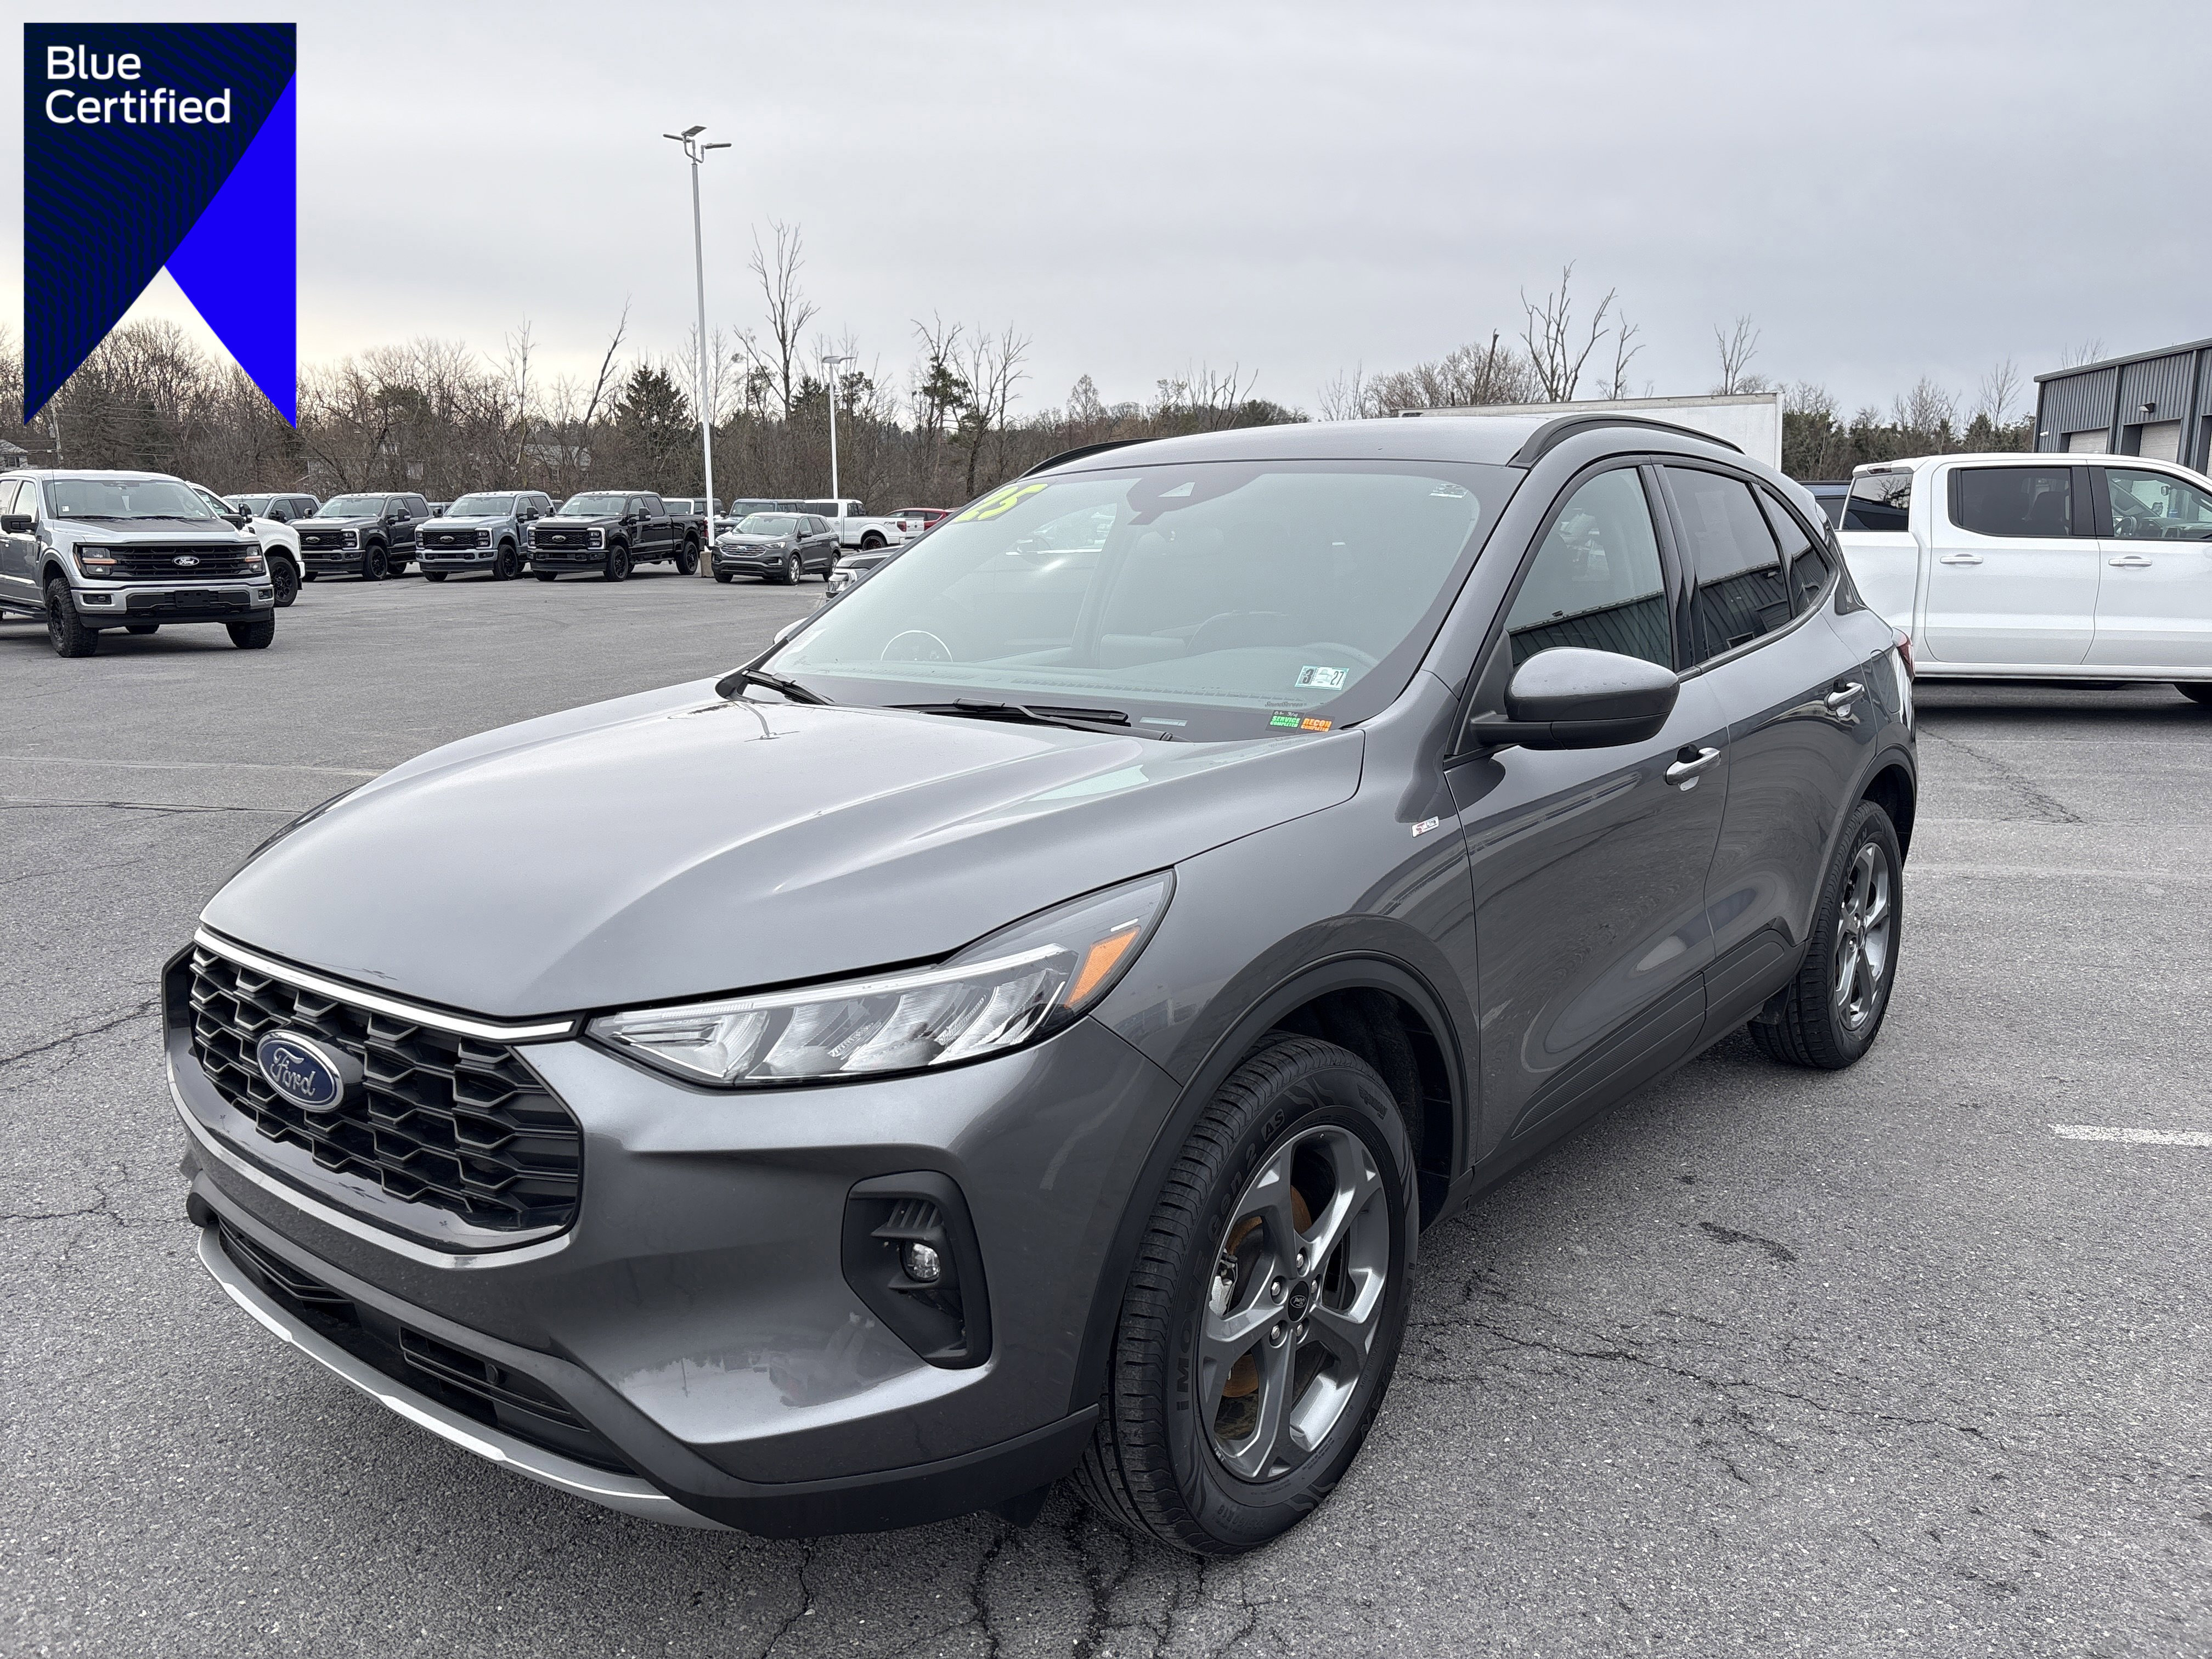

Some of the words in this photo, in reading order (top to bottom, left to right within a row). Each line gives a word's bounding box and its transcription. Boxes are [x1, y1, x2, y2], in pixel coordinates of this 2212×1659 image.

[1302, 669, 1314, 684] 3
[1330, 671, 1344, 686] 27
[1303, 718, 1332, 727] RECON
[270, 1047, 316, 1096] Ford
[1207, 1171, 1243, 1243] Gen
[1246, 1143, 1257, 1171] 2
[1264, 1109, 1284, 1138] AS
